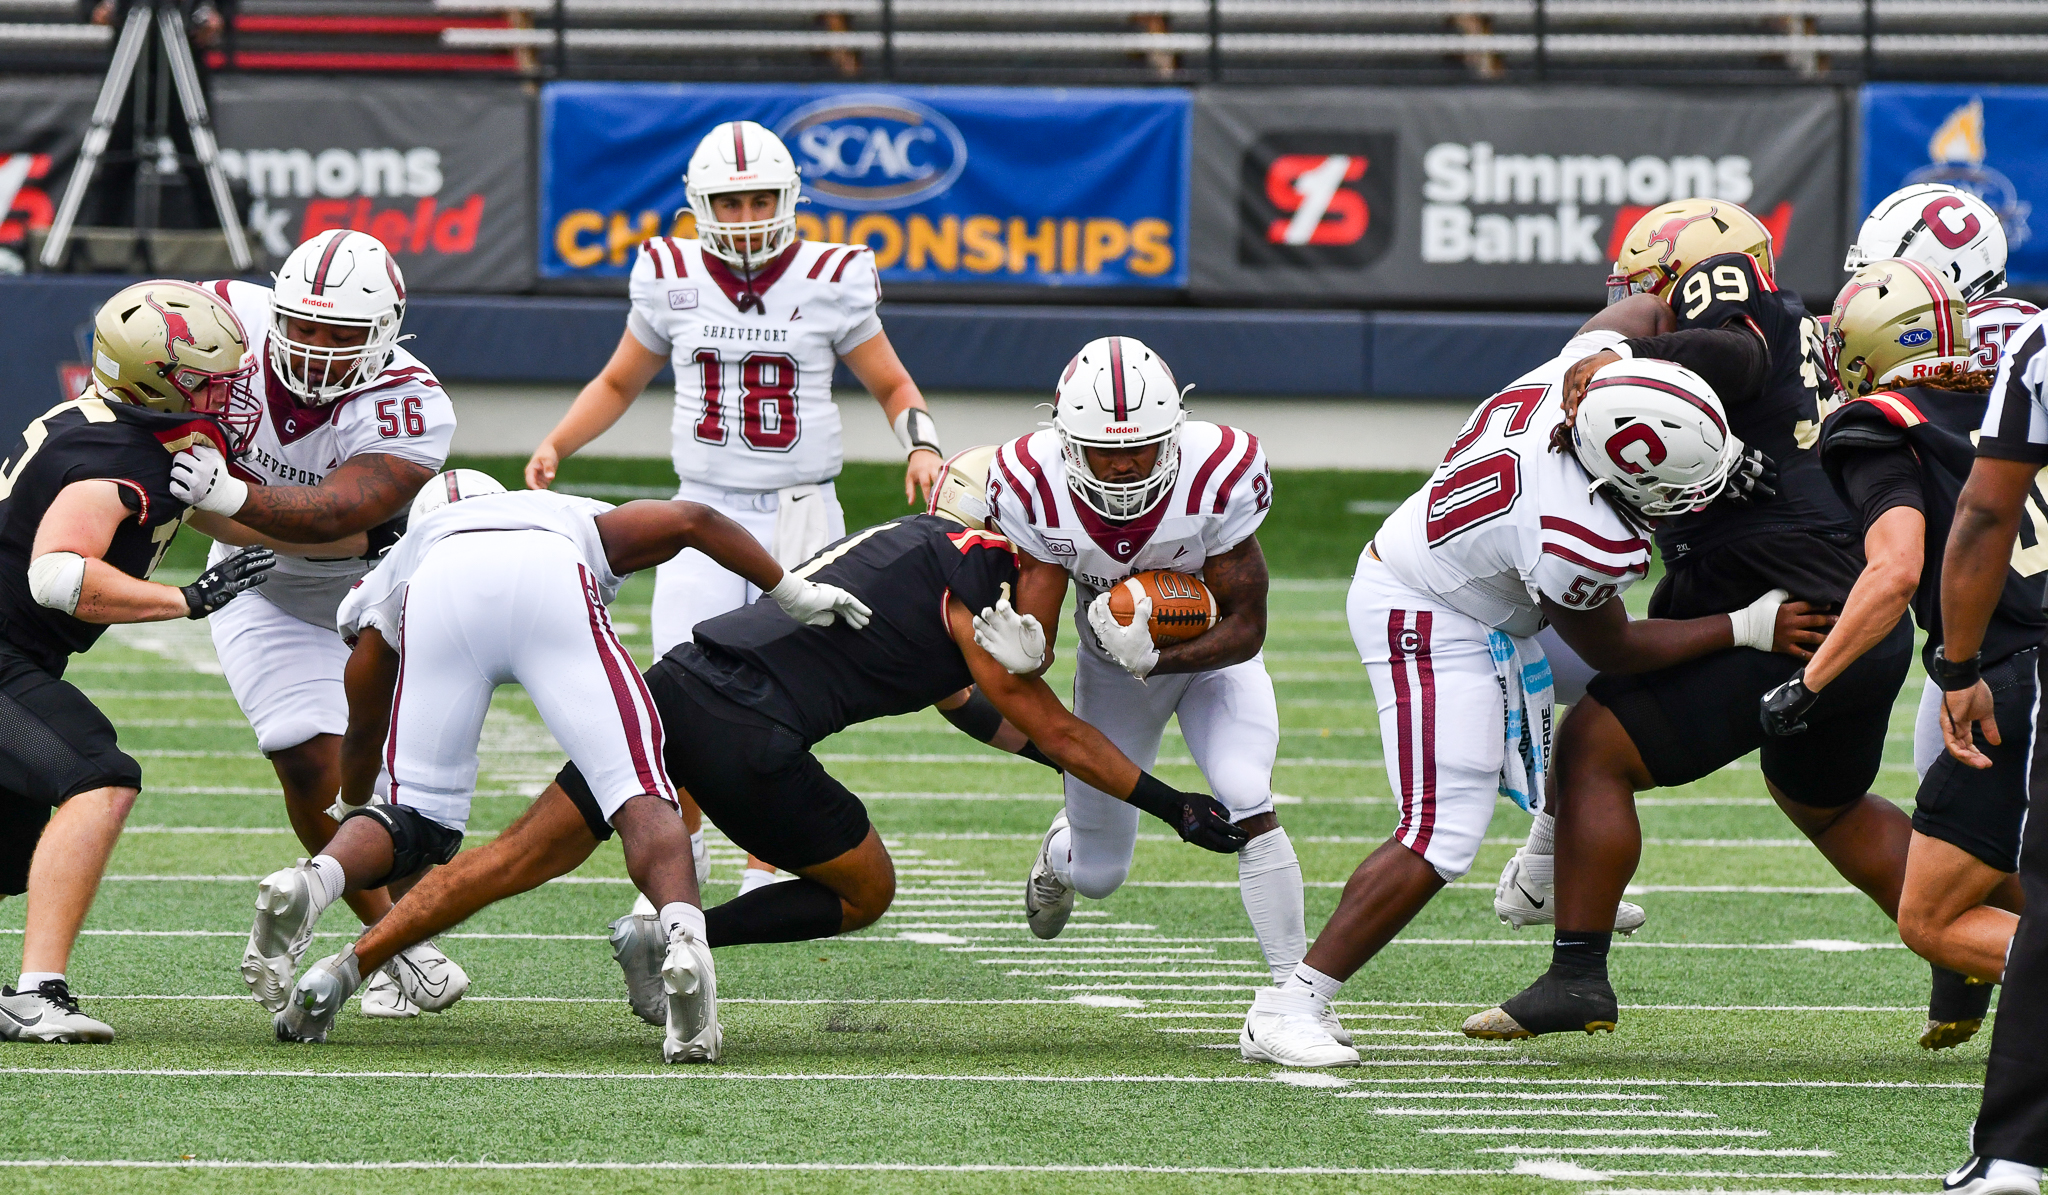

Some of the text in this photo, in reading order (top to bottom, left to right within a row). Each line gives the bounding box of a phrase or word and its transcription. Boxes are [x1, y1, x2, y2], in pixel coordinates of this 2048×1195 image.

[799, 124, 936, 180] SCAC
[1422, 140, 1753, 204] Simmons
[554, 208, 1175, 277] CHIONSHIPS
[1420, 204, 1604, 264] Bank
[1922, 195, 1981, 249] C
[1682, 265, 1749, 320] 99
[703, 325, 788, 342] SHREVEPORT
[1902, 331, 1928, 344] SCAC
[1912, 361, 1970, 378] Ridell
[375, 396, 425, 439] 56
[692, 347, 801, 453] 18
[285, 419, 296, 434] C
[1105, 426, 1140, 434] Riddell
[256, 447, 323, 486] REVEPORT
[1427, 383, 1552, 550] 50
[1605, 423, 1667, 475] C
[1117, 541, 1130, 555] C
[1676, 543, 1691, 552] 2XL
[1562, 575, 1618, 608] 50
[1400, 632, 1418, 650] C
